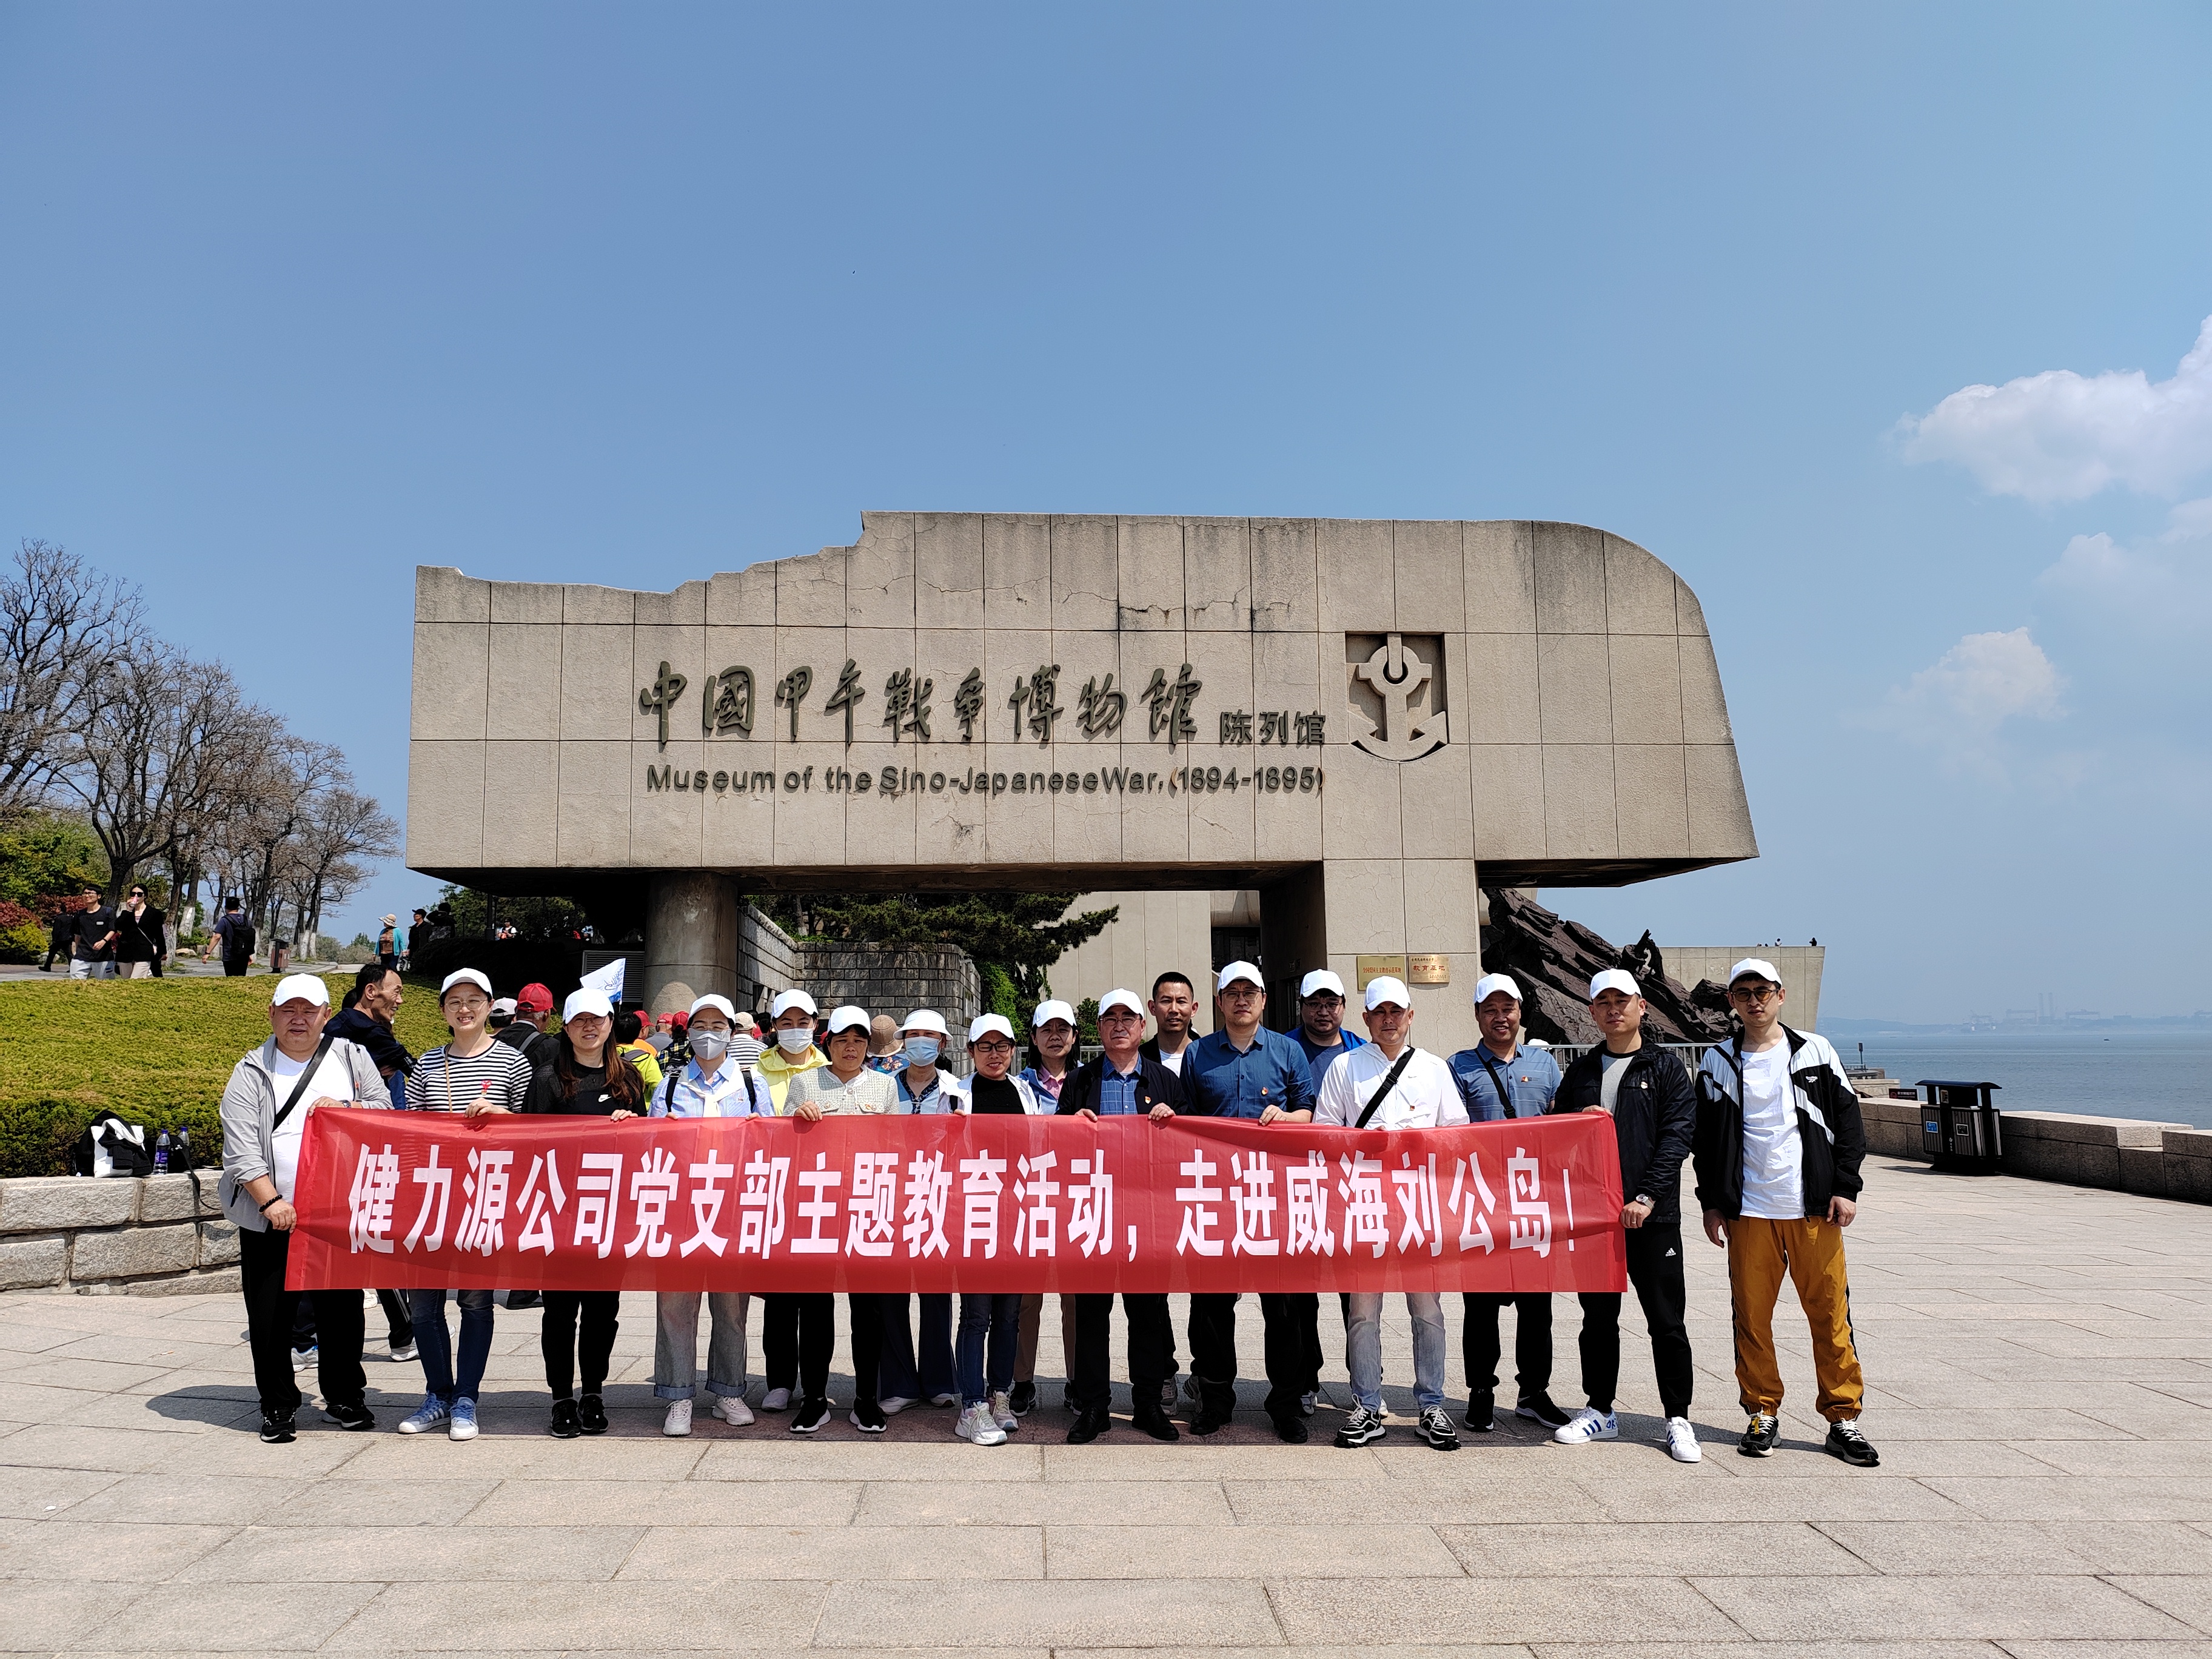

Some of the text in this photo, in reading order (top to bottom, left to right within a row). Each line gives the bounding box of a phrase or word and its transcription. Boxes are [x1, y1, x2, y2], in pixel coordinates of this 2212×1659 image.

[1220, 709, 1326, 743] 陈列馆
[648, 764, 775, 789] Museum
[785, 765, 813, 788] of
[826, 766, 872, 788] the
